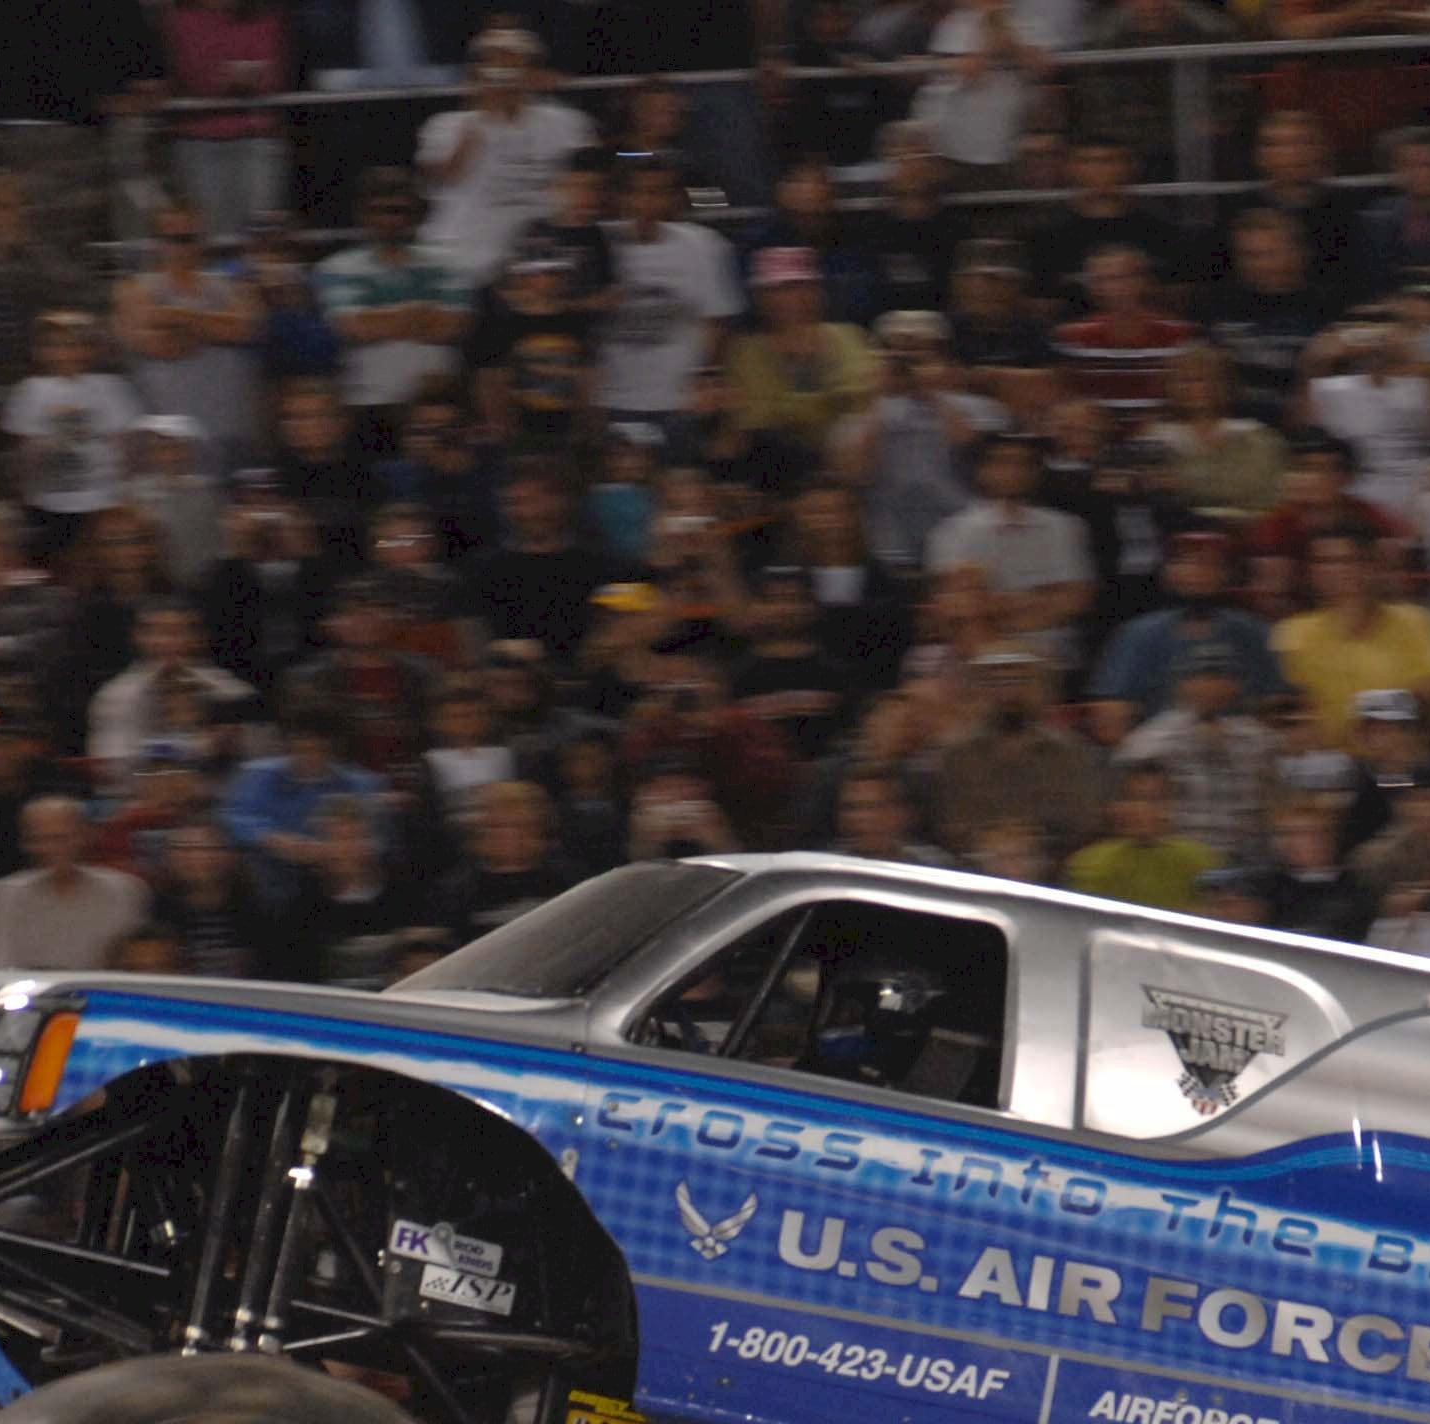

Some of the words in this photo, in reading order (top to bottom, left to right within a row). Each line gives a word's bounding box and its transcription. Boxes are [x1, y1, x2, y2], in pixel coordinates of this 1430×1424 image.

[1141, 1004, 1285, 1056] MONSTER
[1180, 1038, 1246, 1074] JAM
[395, 1226, 430, 1255] FK
[778, 1209, 939, 1293] U.S.
[958, 1246, 1122, 1325] AIR
[708, 1321, 1011, 1400] 1-800-423-USAF
